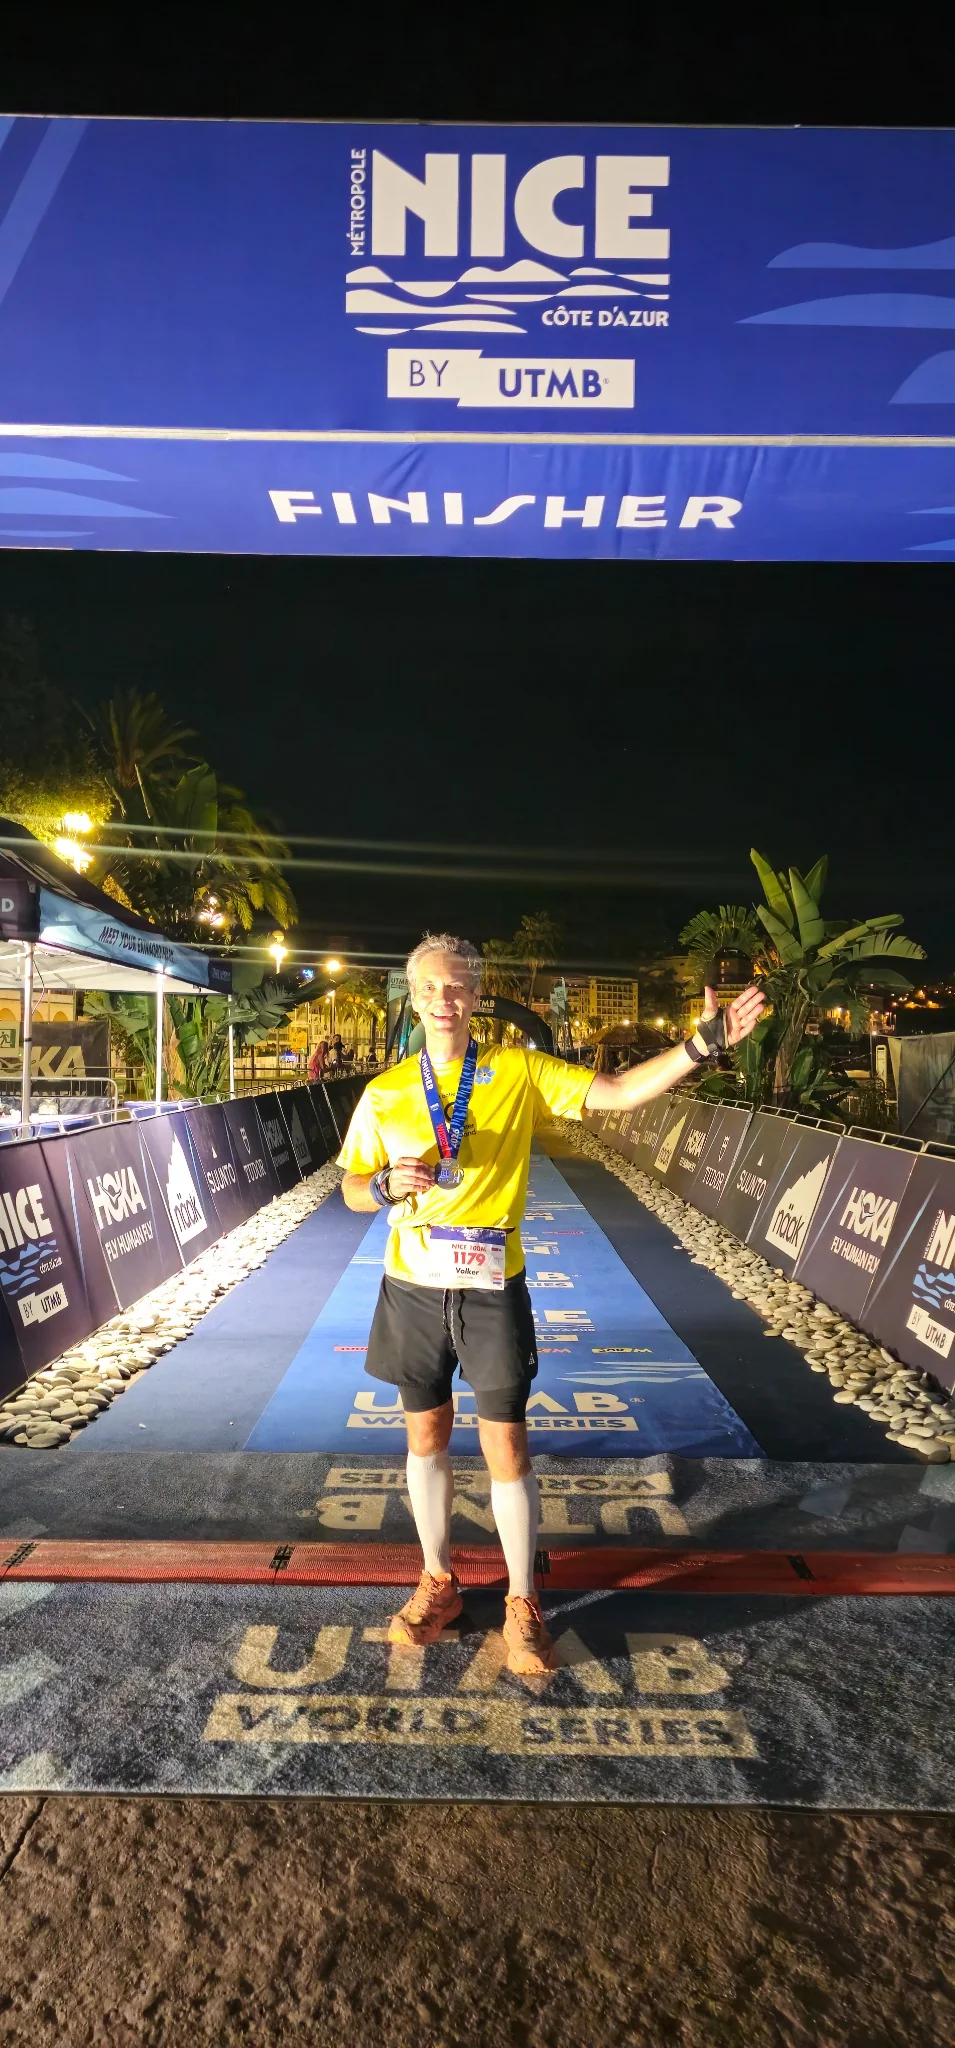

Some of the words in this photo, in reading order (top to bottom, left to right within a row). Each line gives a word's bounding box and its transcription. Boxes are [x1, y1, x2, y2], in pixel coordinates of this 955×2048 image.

[346, 148, 366, 256] MÉTROPOLE
[371, 149, 671, 259] NICE
[541, 305, 593, 327] CÔTE
[598, 305, 669, 327] D'AZUR
[409, 359, 449, 388] BY
[268, 490, 743, 529] FINISHER
[99, 925, 119, 945] MEET
[119, 931, 137, 951] YOUR
[478, 999, 496, 1008] TMB
[2, 1046, 86, 1077] KA
[421, 1054, 434, 1091] FINISHER
[207, 1163, 236, 1193] SUUNTO
[243, 1158, 267, 1183] TUDOR
[702, 1166, 725, 1191] TUDOR
[737, 1169, 767, 1201] SUUNTO
[87, 1166, 147, 1230] HOKA
[0, 1184, 53, 1254] NICE
[839, 1186, 898, 1248] HOKA
[105, 1238, 119, 1262] FLY
[116, 1226, 142, 1256] HUMAN
[141, 1220, 154, 1243] FLY
[830, 1235, 844, 1255] FLY
[840, 1241, 867, 1271] HUMAN
[865, 1254, 881, 1275] FLY
[453, 1251, 486, 1267] 1179
[455, 1267, 480, 1276] Volker
[22, 1301, 34, 1319] BY
[40, 1291, 62, 1314] UTMB
[911, 1311, 922, 1328] BY
[925, 1324, 947, 1349] UTMB
[340, 1472, 474, 1486] SIES
[536, 1479, 657, 1491] WOR
[232, 1625, 734, 1695] UTMB
[237, 1704, 488, 1736] WORLD
[520, 1717, 734, 1746] SERIES
